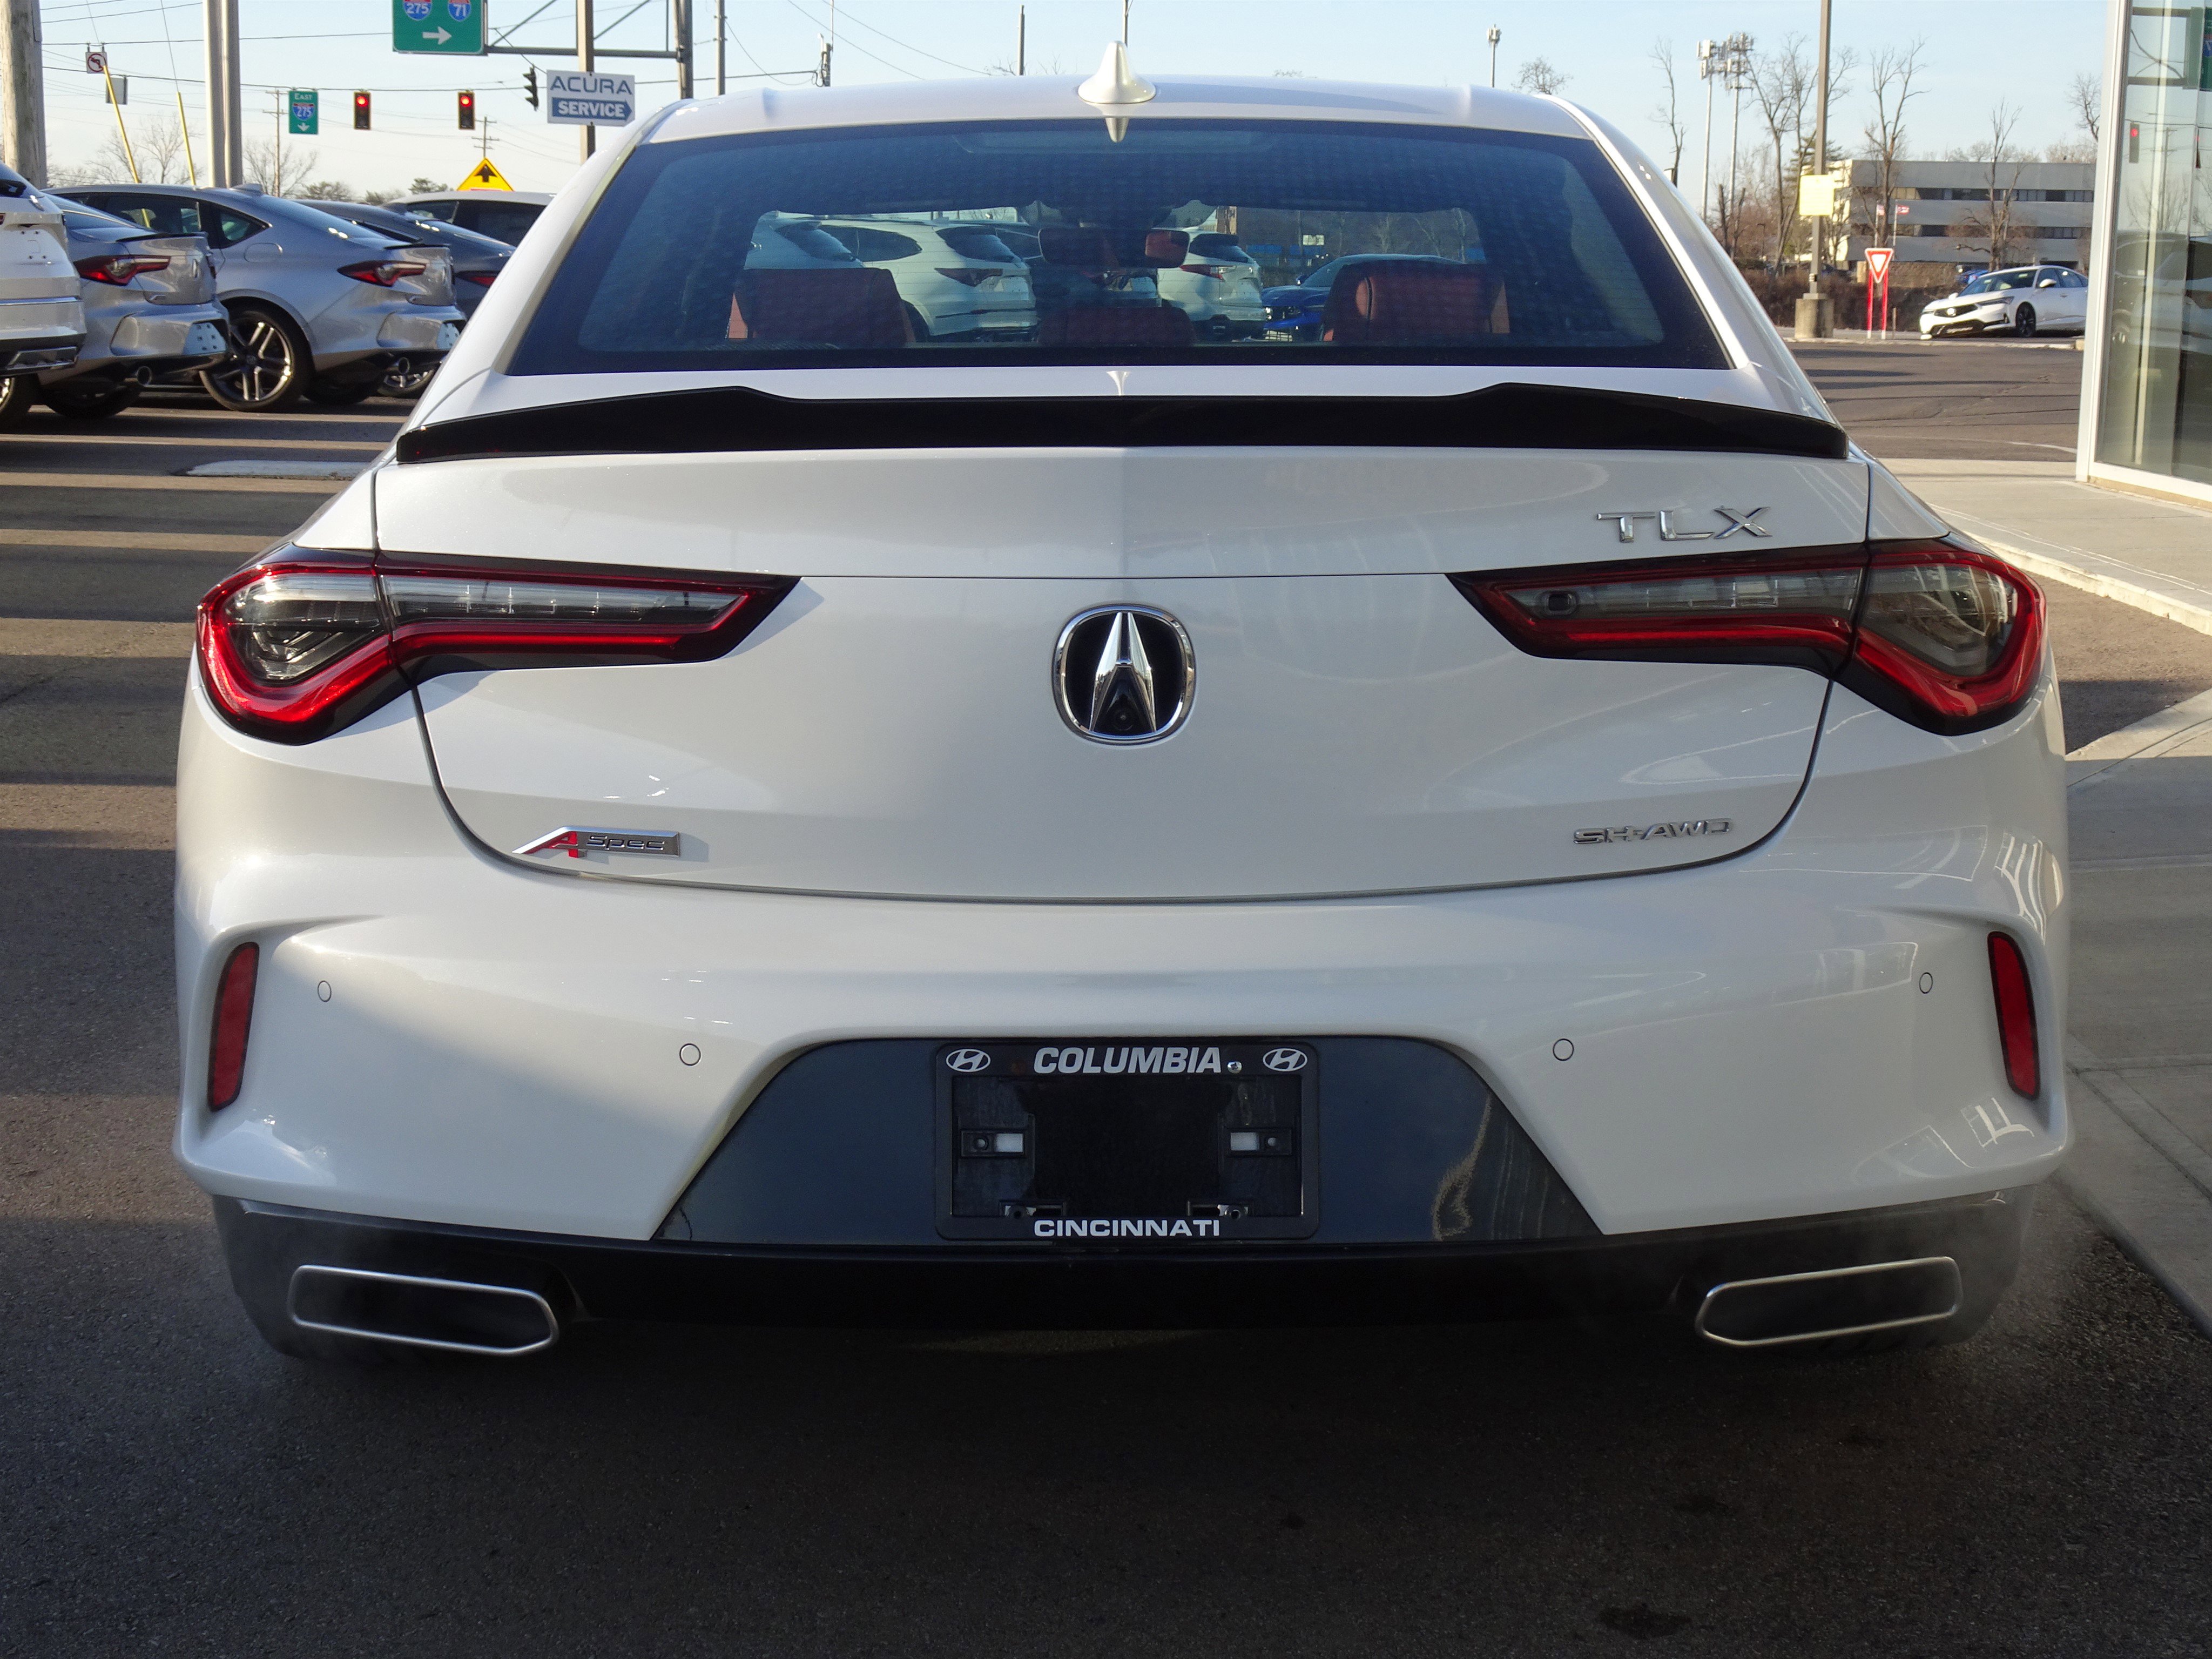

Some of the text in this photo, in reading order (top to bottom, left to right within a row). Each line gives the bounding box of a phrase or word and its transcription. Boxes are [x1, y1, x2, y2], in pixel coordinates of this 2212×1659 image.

[407, 3, 467, 17] 275 71
[550, 76, 633, 95] ACURA
[297, 106, 312, 117] 275
[558, 100, 625, 117] SERVICE
[1596, 505, 1773, 543] TLX
[1573, 818, 1733, 845] SH-AWD
[1034, 1047, 1222, 1074] COLUMBIA
[1034, 1219, 1220, 1237] CINCINNATI
